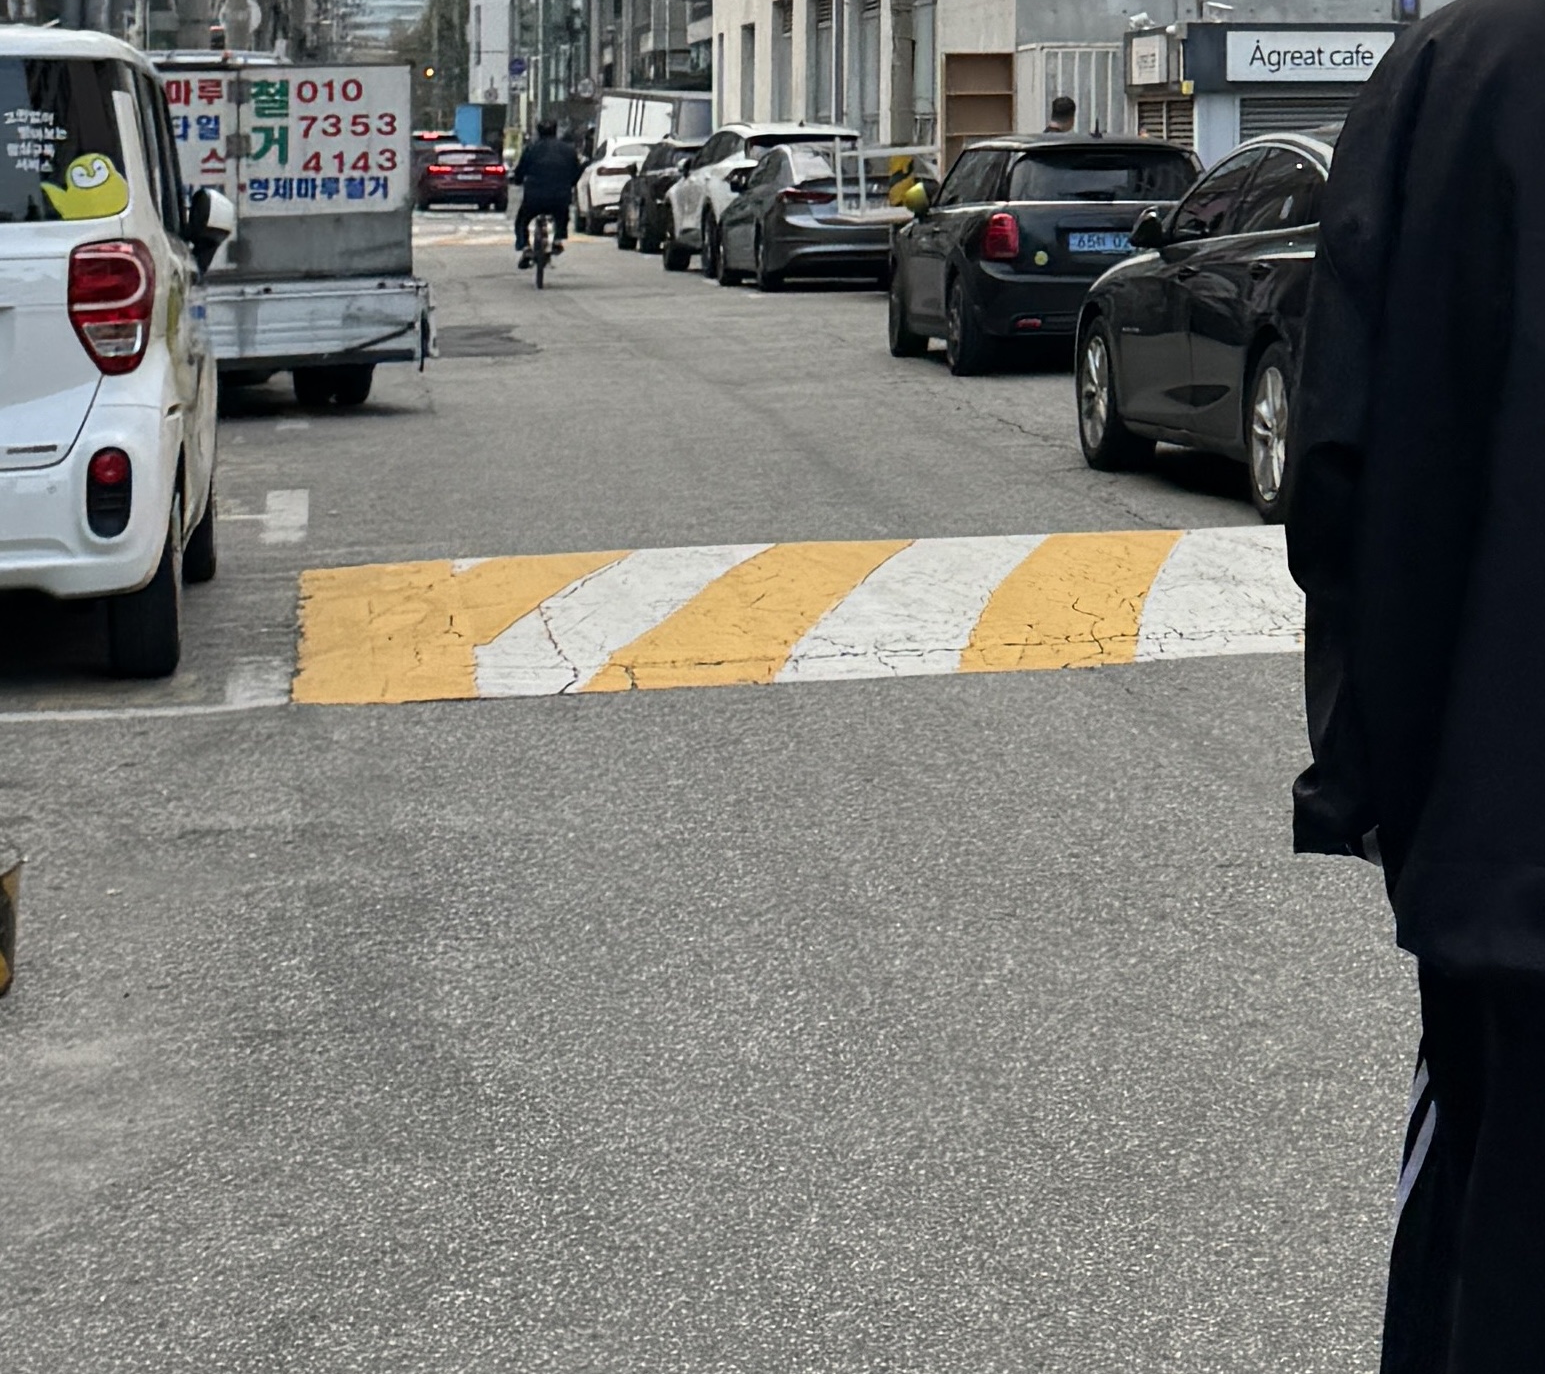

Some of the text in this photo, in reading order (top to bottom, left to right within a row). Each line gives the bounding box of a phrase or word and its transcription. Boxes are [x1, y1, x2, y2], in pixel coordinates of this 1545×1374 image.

[1329, 43, 1374, 67] cafe
[166, 79, 224, 106] 마루
[296, 78, 363, 103] 010
[250, 79, 290, 165] 철거
[298, 112, 398, 139] 7353
[302, 148, 398, 174] 4143
